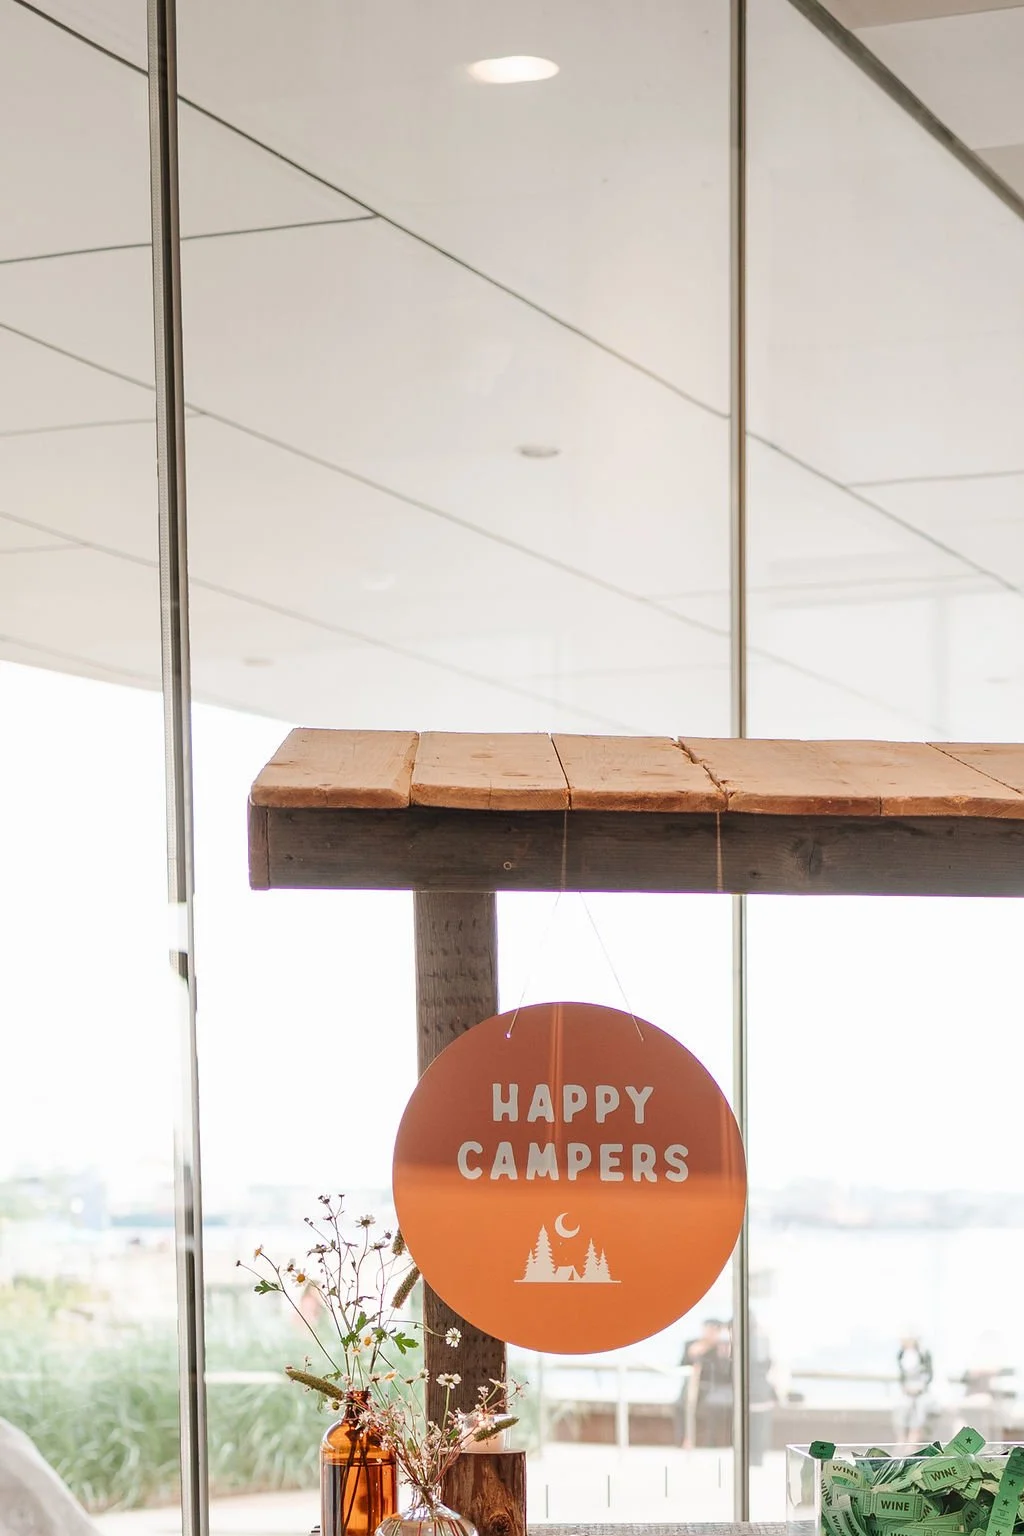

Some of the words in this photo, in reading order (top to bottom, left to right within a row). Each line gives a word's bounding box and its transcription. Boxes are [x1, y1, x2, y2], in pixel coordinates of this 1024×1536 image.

[492, 1083, 654, 1124] HAPPY
[457, 1141, 689, 1183] CAMPERS
[832, 1465, 859, 1479] WINE
[931, 1466, 958, 1482] WINE
[881, 1500, 910, 1512] WINE
